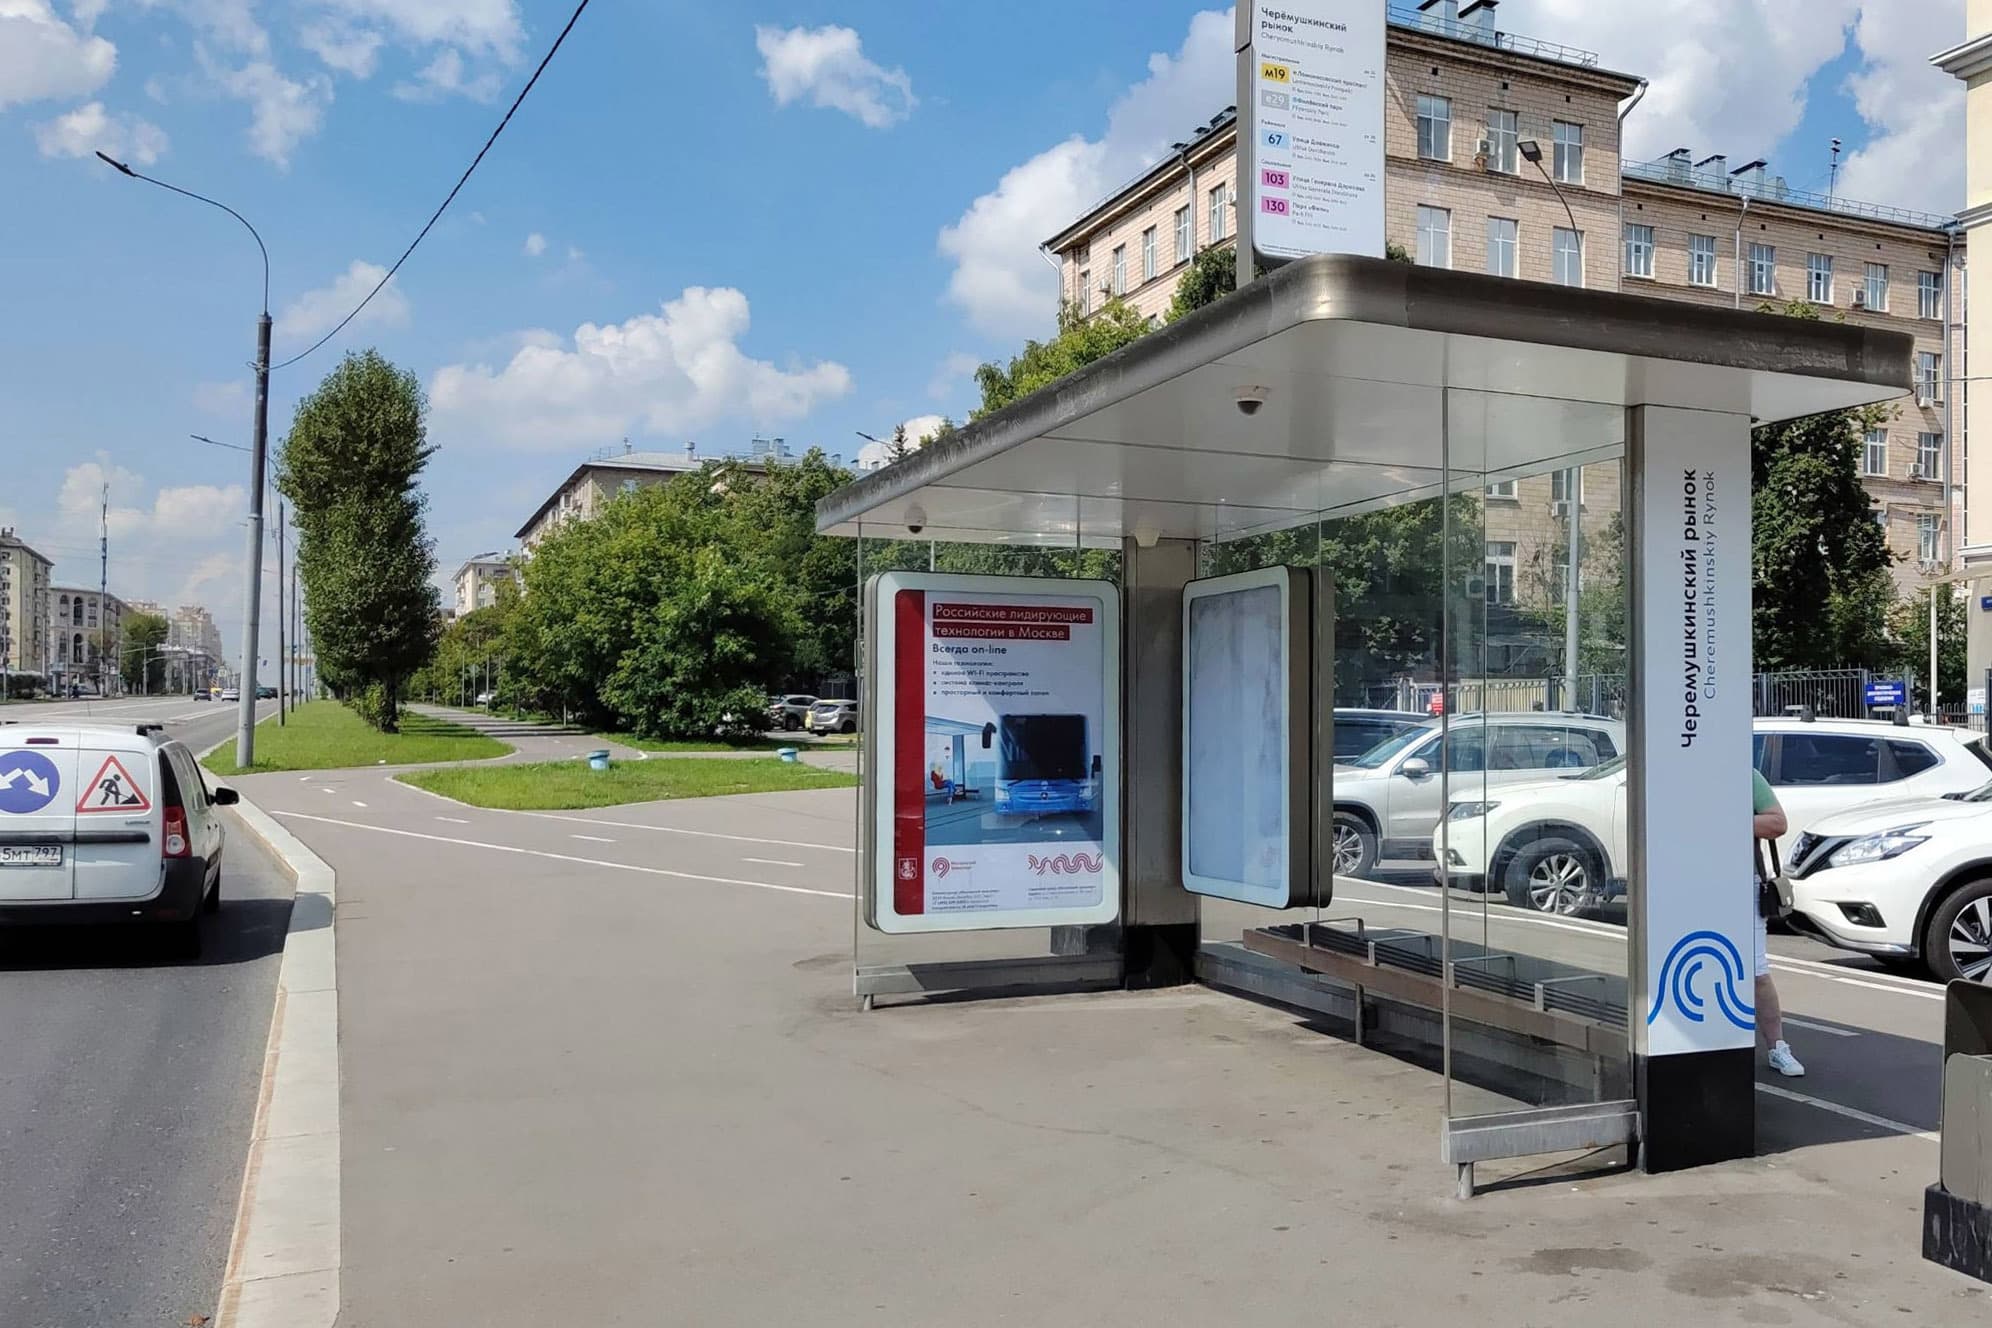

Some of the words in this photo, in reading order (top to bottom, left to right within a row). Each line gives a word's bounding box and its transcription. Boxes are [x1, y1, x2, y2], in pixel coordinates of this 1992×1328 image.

[1261, 6, 1347, 32] Черёмушкинский
[1261, 20, 1294, 33] рынок
[1268, 133, 1282, 146] 67
[1266, 172, 1285, 186] 103
[1266, 199, 1285, 213] 130
[1684, 468, 1700, 541] рынок
[1702, 471, 1717, 525] Rynok
[935, 604, 1007, 619] Российские
[1009, 608, 1087, 623] лидирующие
[1703, 530, 1718, 699] Cheremushkinskiy
[935, 626, 1005, 638] технологии
[1008, 628, 1015, 638] в
[1018, 626, 1065, 639] Москве
[932, 643, 969, 655] Всегда
[971, 643, 1008, 655] on-line
[1680, 549, 1701, 748] Черемушкинский
[35, 847, 58, 858] 797
